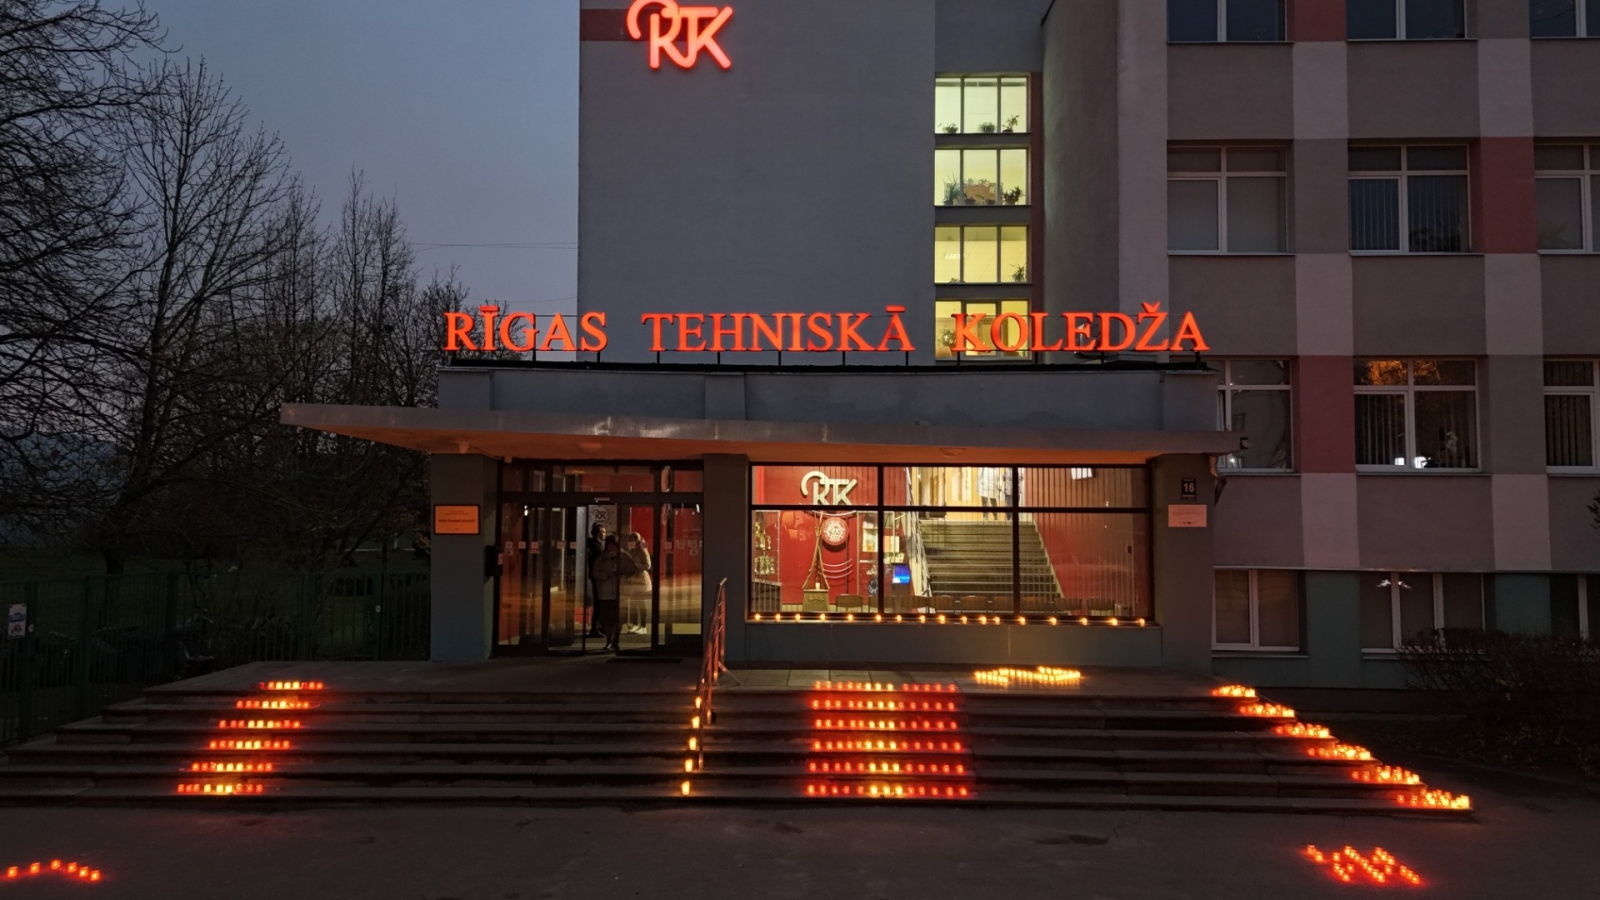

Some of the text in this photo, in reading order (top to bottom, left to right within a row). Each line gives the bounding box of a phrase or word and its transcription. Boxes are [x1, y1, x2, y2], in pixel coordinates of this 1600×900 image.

[626, 0, 733, 69] RTK
[443, 301, 1210, 353] RĪGAS TEHNISKĀ KOLEDŽA
[801, 470, 858, 506] RTK
[1183, 482, 1195, 492] 16
